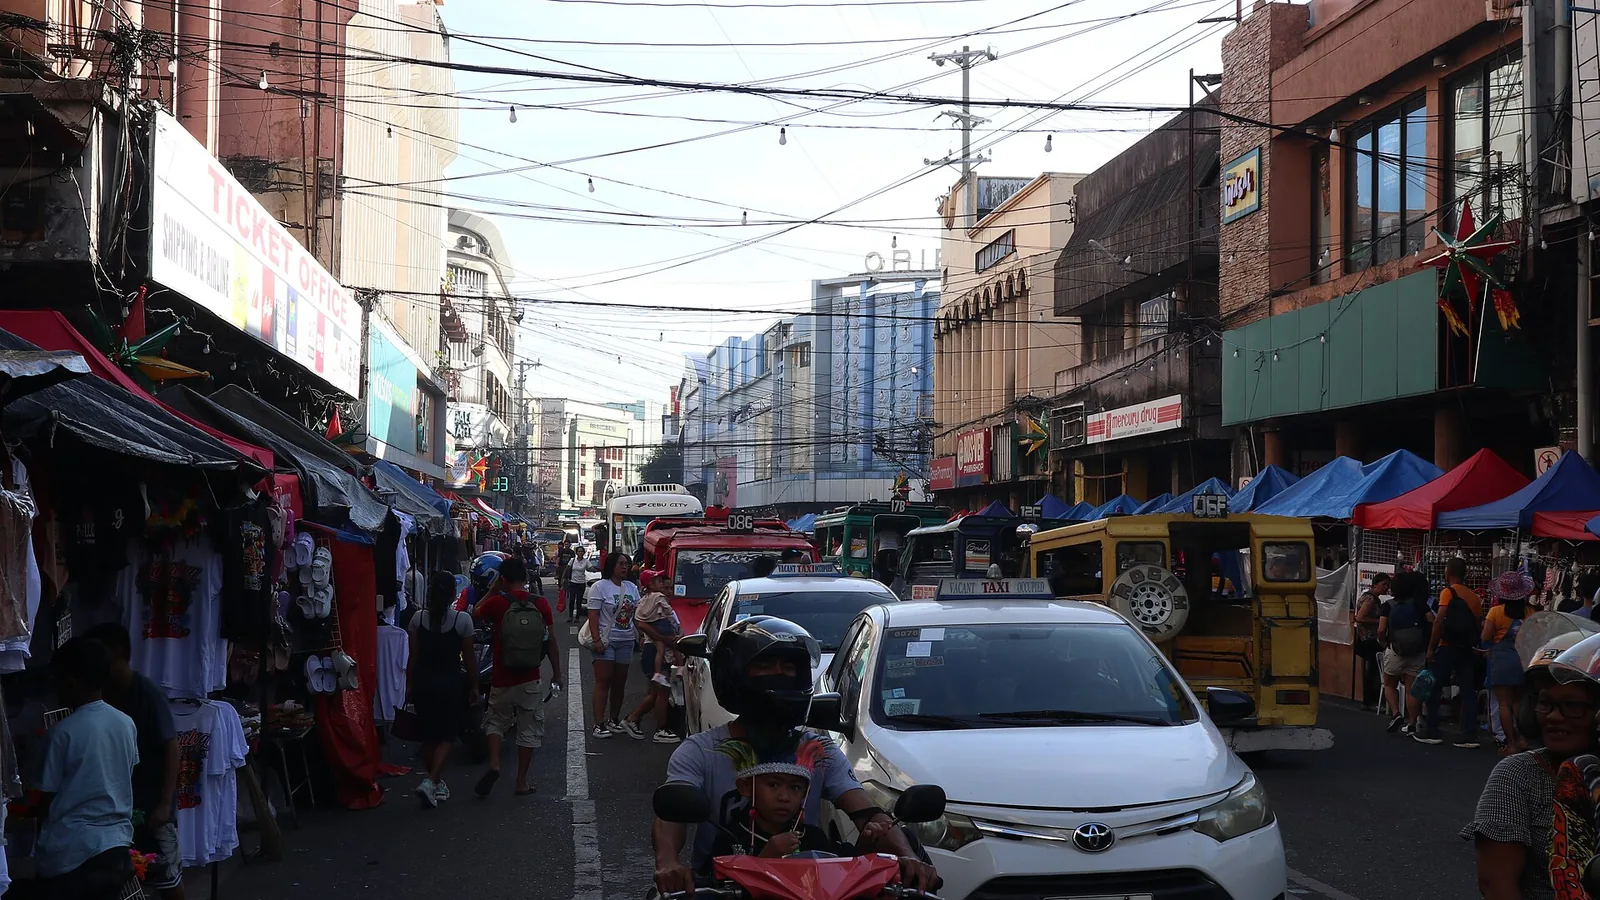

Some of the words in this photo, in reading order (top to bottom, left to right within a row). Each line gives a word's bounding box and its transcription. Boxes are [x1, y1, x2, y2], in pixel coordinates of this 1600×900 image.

[208, 163, 293, 274] TICKET
[299, 255, 348, 326] OFFICE
[163, 212, 198, 277] SHIPPING
[200, 241, 205, 282] &
[206, 245, 230, 298] AIRLINE
[1112, 410, 1140, 428] mercury
[1141, 406, 1157, 424] drug
[964, 462, 985, 474] PAWNSHOP
[891, 500, 906, 513] 17B
[1020, 505, 1042, 517] 12C
[728, 514, 753, 530] 08G
[778, 564, 796, 573] VACANT
[797, 564, 814, 573] TAXI
[949, 582, 975, 594] VACANT
[981, 581, 1010, 594] TAXI
[1016, 581, 1045, 593] OCCUPIED
